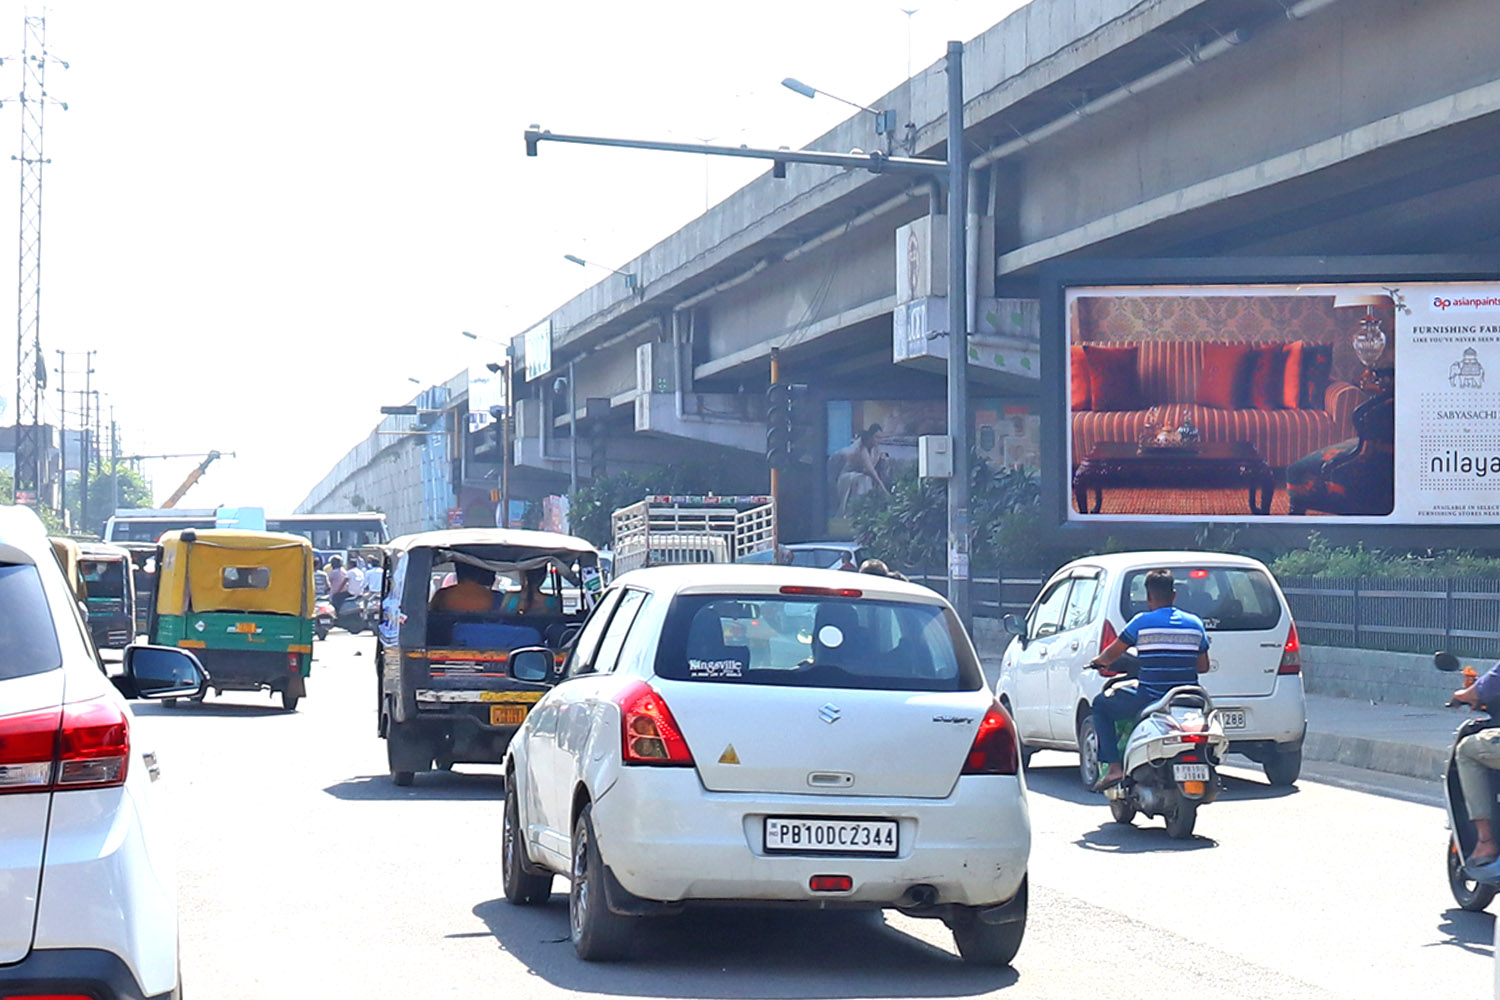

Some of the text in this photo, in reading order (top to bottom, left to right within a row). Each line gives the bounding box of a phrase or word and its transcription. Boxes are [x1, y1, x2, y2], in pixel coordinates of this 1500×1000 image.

[1412, 325, 1477, 334] FURNISHING
[1436, 410, 1498, 420] SABYASACHI
[780, 824, 894, 846] PB10DC2344
